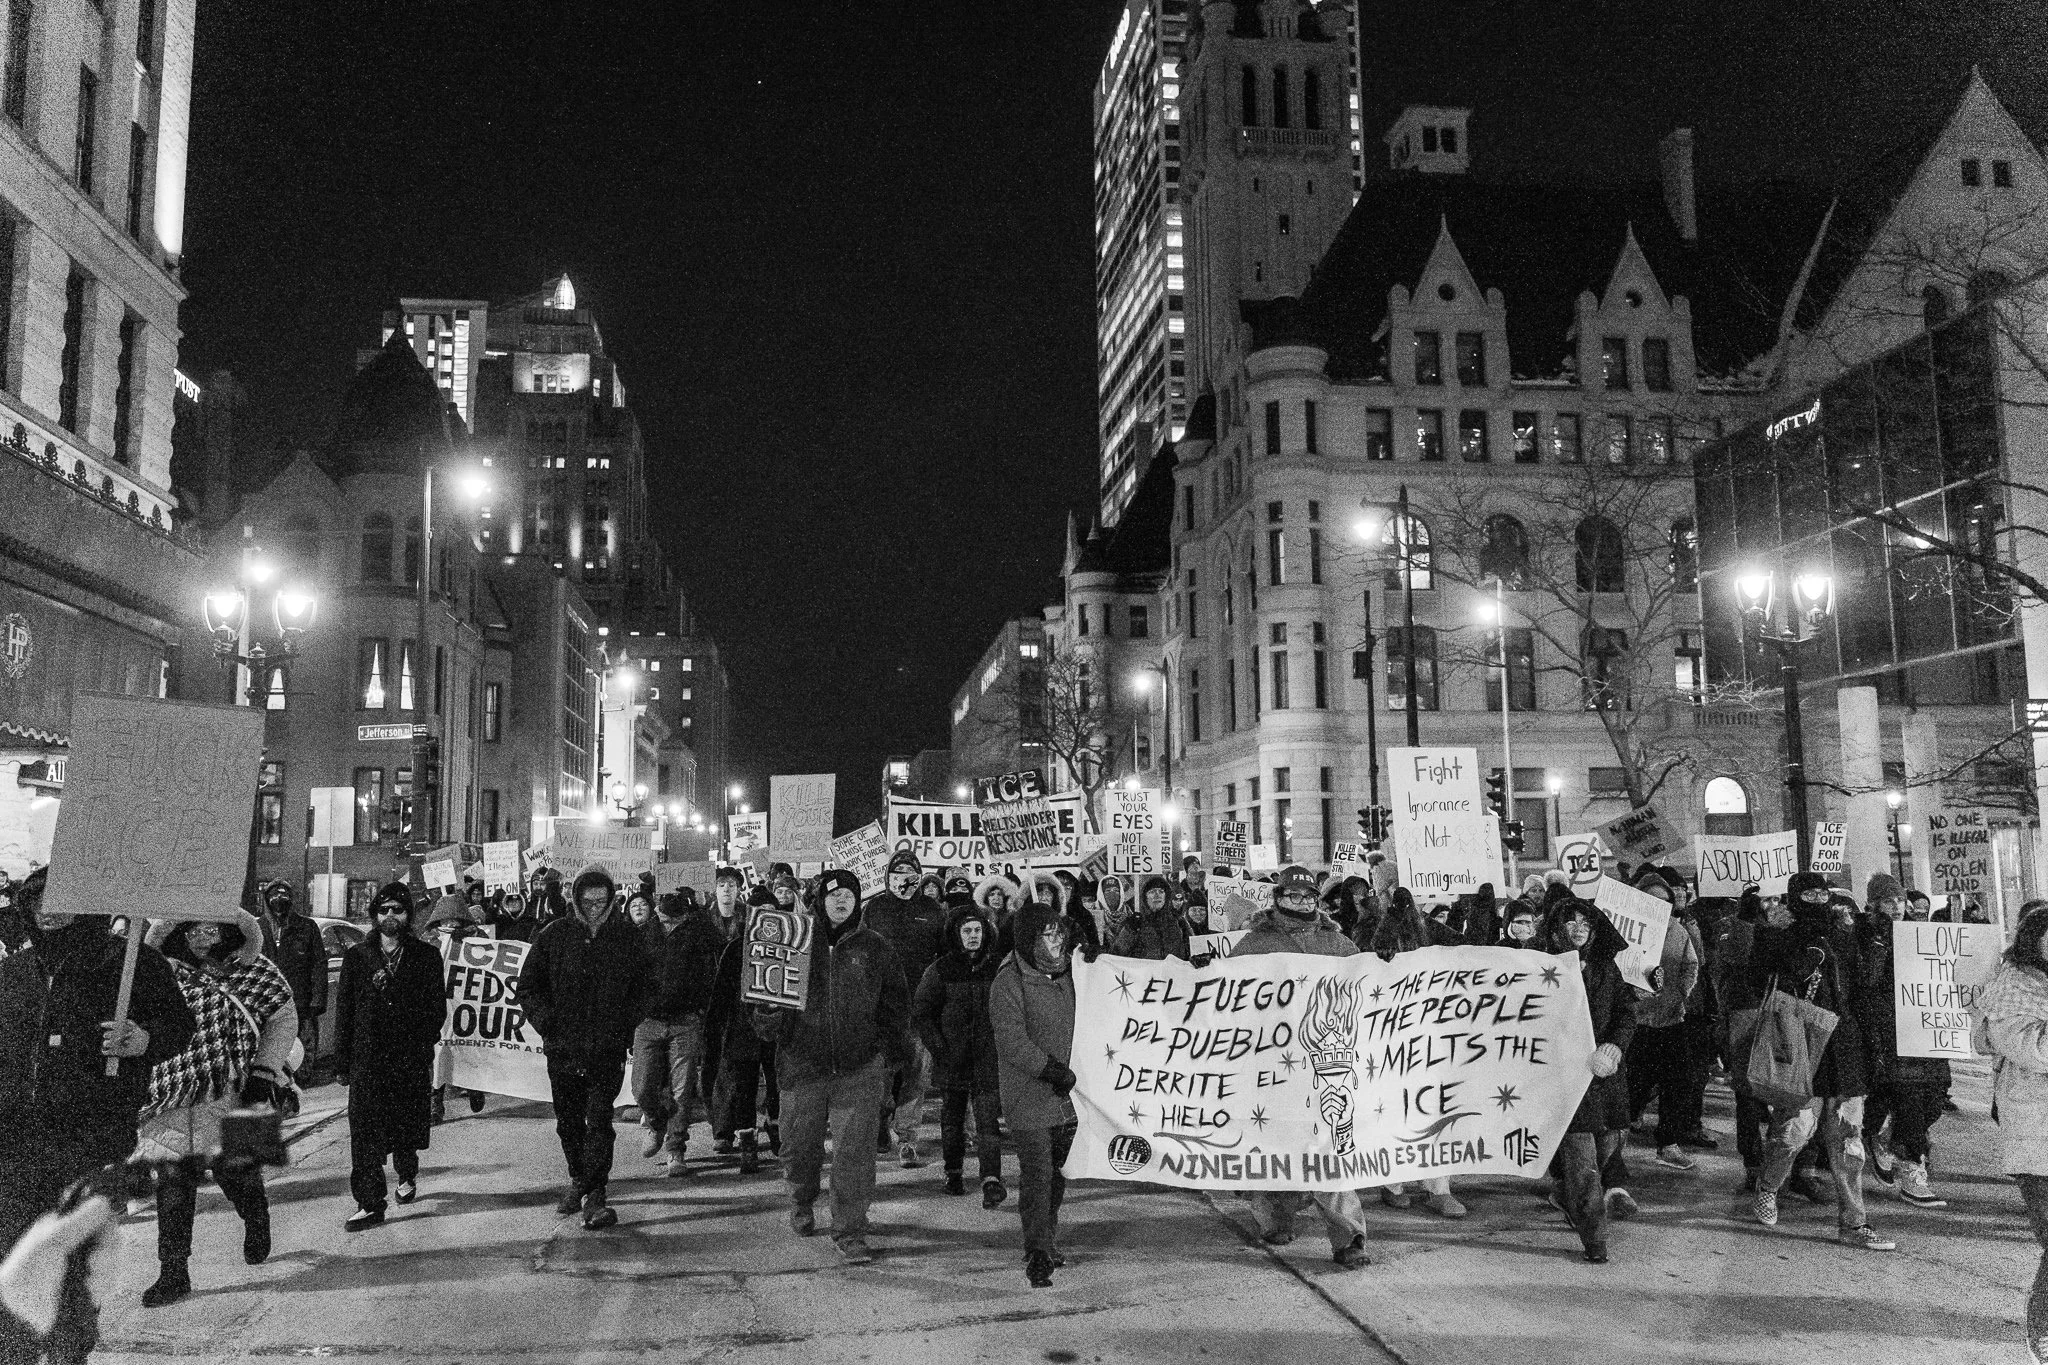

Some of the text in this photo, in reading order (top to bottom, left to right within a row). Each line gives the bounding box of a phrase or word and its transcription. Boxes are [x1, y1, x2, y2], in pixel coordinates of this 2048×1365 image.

[365, 728, 402, 738] Jefferson
[1414, 755, 1462, 785] Fight
[779, 782, 832, 807] KILL
[978, 771, 1041, 803] ICE
[1114, 791, 1150, 802] TRUST
[1120, 802, 1148, 812] YOUR
[1408, 791, 1470, 821] Ignorance
[780, 806, 832, 832] YOUR
[897, 813, 986, 837] KILLE
[982, 816, 1016, 832] MELTS
[1113, 813, 1153, 829] EYES
[1220, 821, 1246, 833] KILLER
[1824, 823, 1843, 834] ICE
[1929, 812, 1984, 830] NO ONE
[833, 829, 867, 852] SOME OF
[986, 825, 1060, 855] RESISTANCE
[1122, 832, 1143, 844] NOT
[1217, 831, 1246, 843] ICE
[1424, 824, 1451, 848] Not
[1820, 835, 1843, 846] OUT
[1933, 830, 1989, 847] IS ILLEGAL
[839, 834, 881, 859] THOSE THAT
[894, 838, 986, 859] OFF OUR
[1114, 843, 1149, 855] THEIR
[1215, 846, 1246, 858] STREETS
[1334, 851, 1356, 861] ICE
[1338, 843, 1356, 852] KILLER
[1818, 849, 1839, 859] FOR
[1948, 847, 1967, 860] ON
[554, 857, 589, 868] STAND
[843, 845, 887, 869] WORK FORCES
[862, 859, 876, 871] THE
[1113, 855, 1153, 873] LIES
[1567, 854, 1598, 874] ICE
[1700, 844, 1795, 882] ABOLISH ICE
[1812, 861, 1842, 871] GOOD
[657, 867, 685, 886] FUCK
[858, 872, 871, 882] AME
[1408, 858, 1477, 892] Immigrants
[1935, 858, 1987, 878] STOLEN
[1209, 881, 1237, 896] TRUST
[1238, 882, 1257, 901] YOUR
[1945, 878, 1979, 892] LAND
[1207, 936, 1231, 959] NO
[1916, 926, 1972, 957] LOVE
[449, 941, 523, 976] ICE
[750, 944, 796, 962] MELT
[750, 961, 799, 998] ICE
[1924, 958, 1957, 981] THY
[446, 964, 520, 1006] FEDS
[1389, 968, 1532, 1001] THE FIRE OF
[1137, 976, 1295, 1024] EL FUEGO
[1902, 983, 1984, 1009] NEIGHBO
[452, 1003, 526, 1043] OUR
[1363, 993, 1550, 1041] THE PEOPLE
[1921, 1011, 1972, 1029] RESIST
[438, 1039, 495, 1048] STUDENTS
[499, 1042, 521, 1050] FOR
[525, 1045, 533, 1053] A
[1121, 1016, 1292, 1064] DEL PUEBLO
[1933, 1030, 1960, 1049] ICE
[1379, 1033, 1549, 1078] MELTS THE
[1114, 1063, 1288, 1100] DERRITE EL
[1402, 1080, 1466, 1124] ICE
[1160, 1103, 1231, 1130] HIELO
[1302, 1147, 1391, 1183] HUMANO
[1395, 1144, 1416, 1166] ES
[1417, 1136, 1493, 1168] ILEGAL
